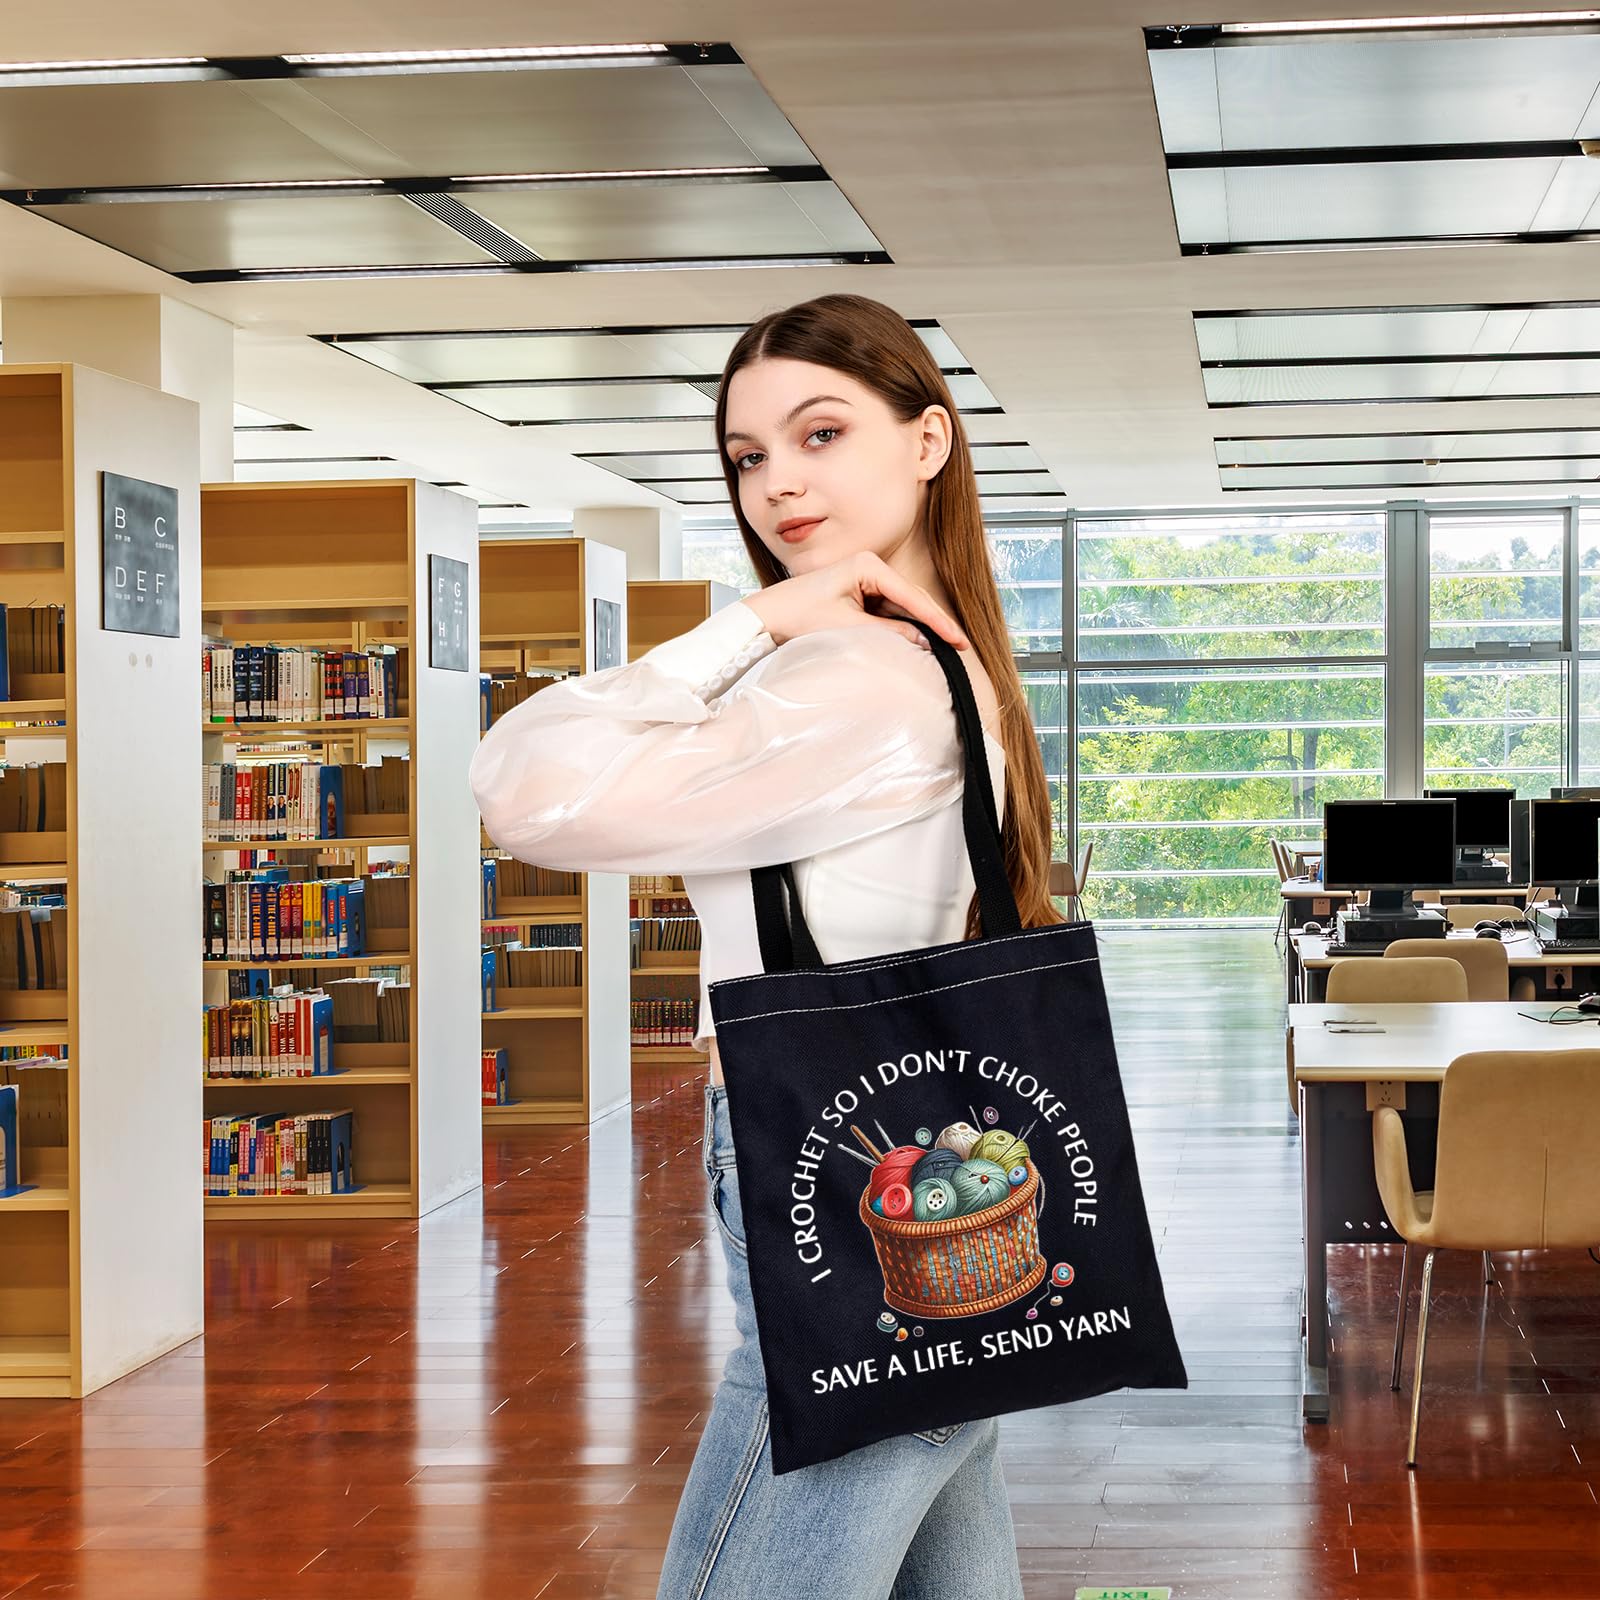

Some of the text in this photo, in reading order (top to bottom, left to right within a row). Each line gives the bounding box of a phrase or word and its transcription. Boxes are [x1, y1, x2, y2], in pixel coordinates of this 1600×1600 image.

[114, 506, 167, 538] B C
[114, 566, 166, 594] D E F
[438, 577, 461, 598] F G
[438, 621, 446, 638] H
[791, 1050, 1098, 1283] I CROCHET SO I DON'T CHOKE PEOPLE
[812, 1306, 1132, 1393] SAVE A LIFE, SEND YARN
[1098, 1591, 1148, 1599] EXIT
